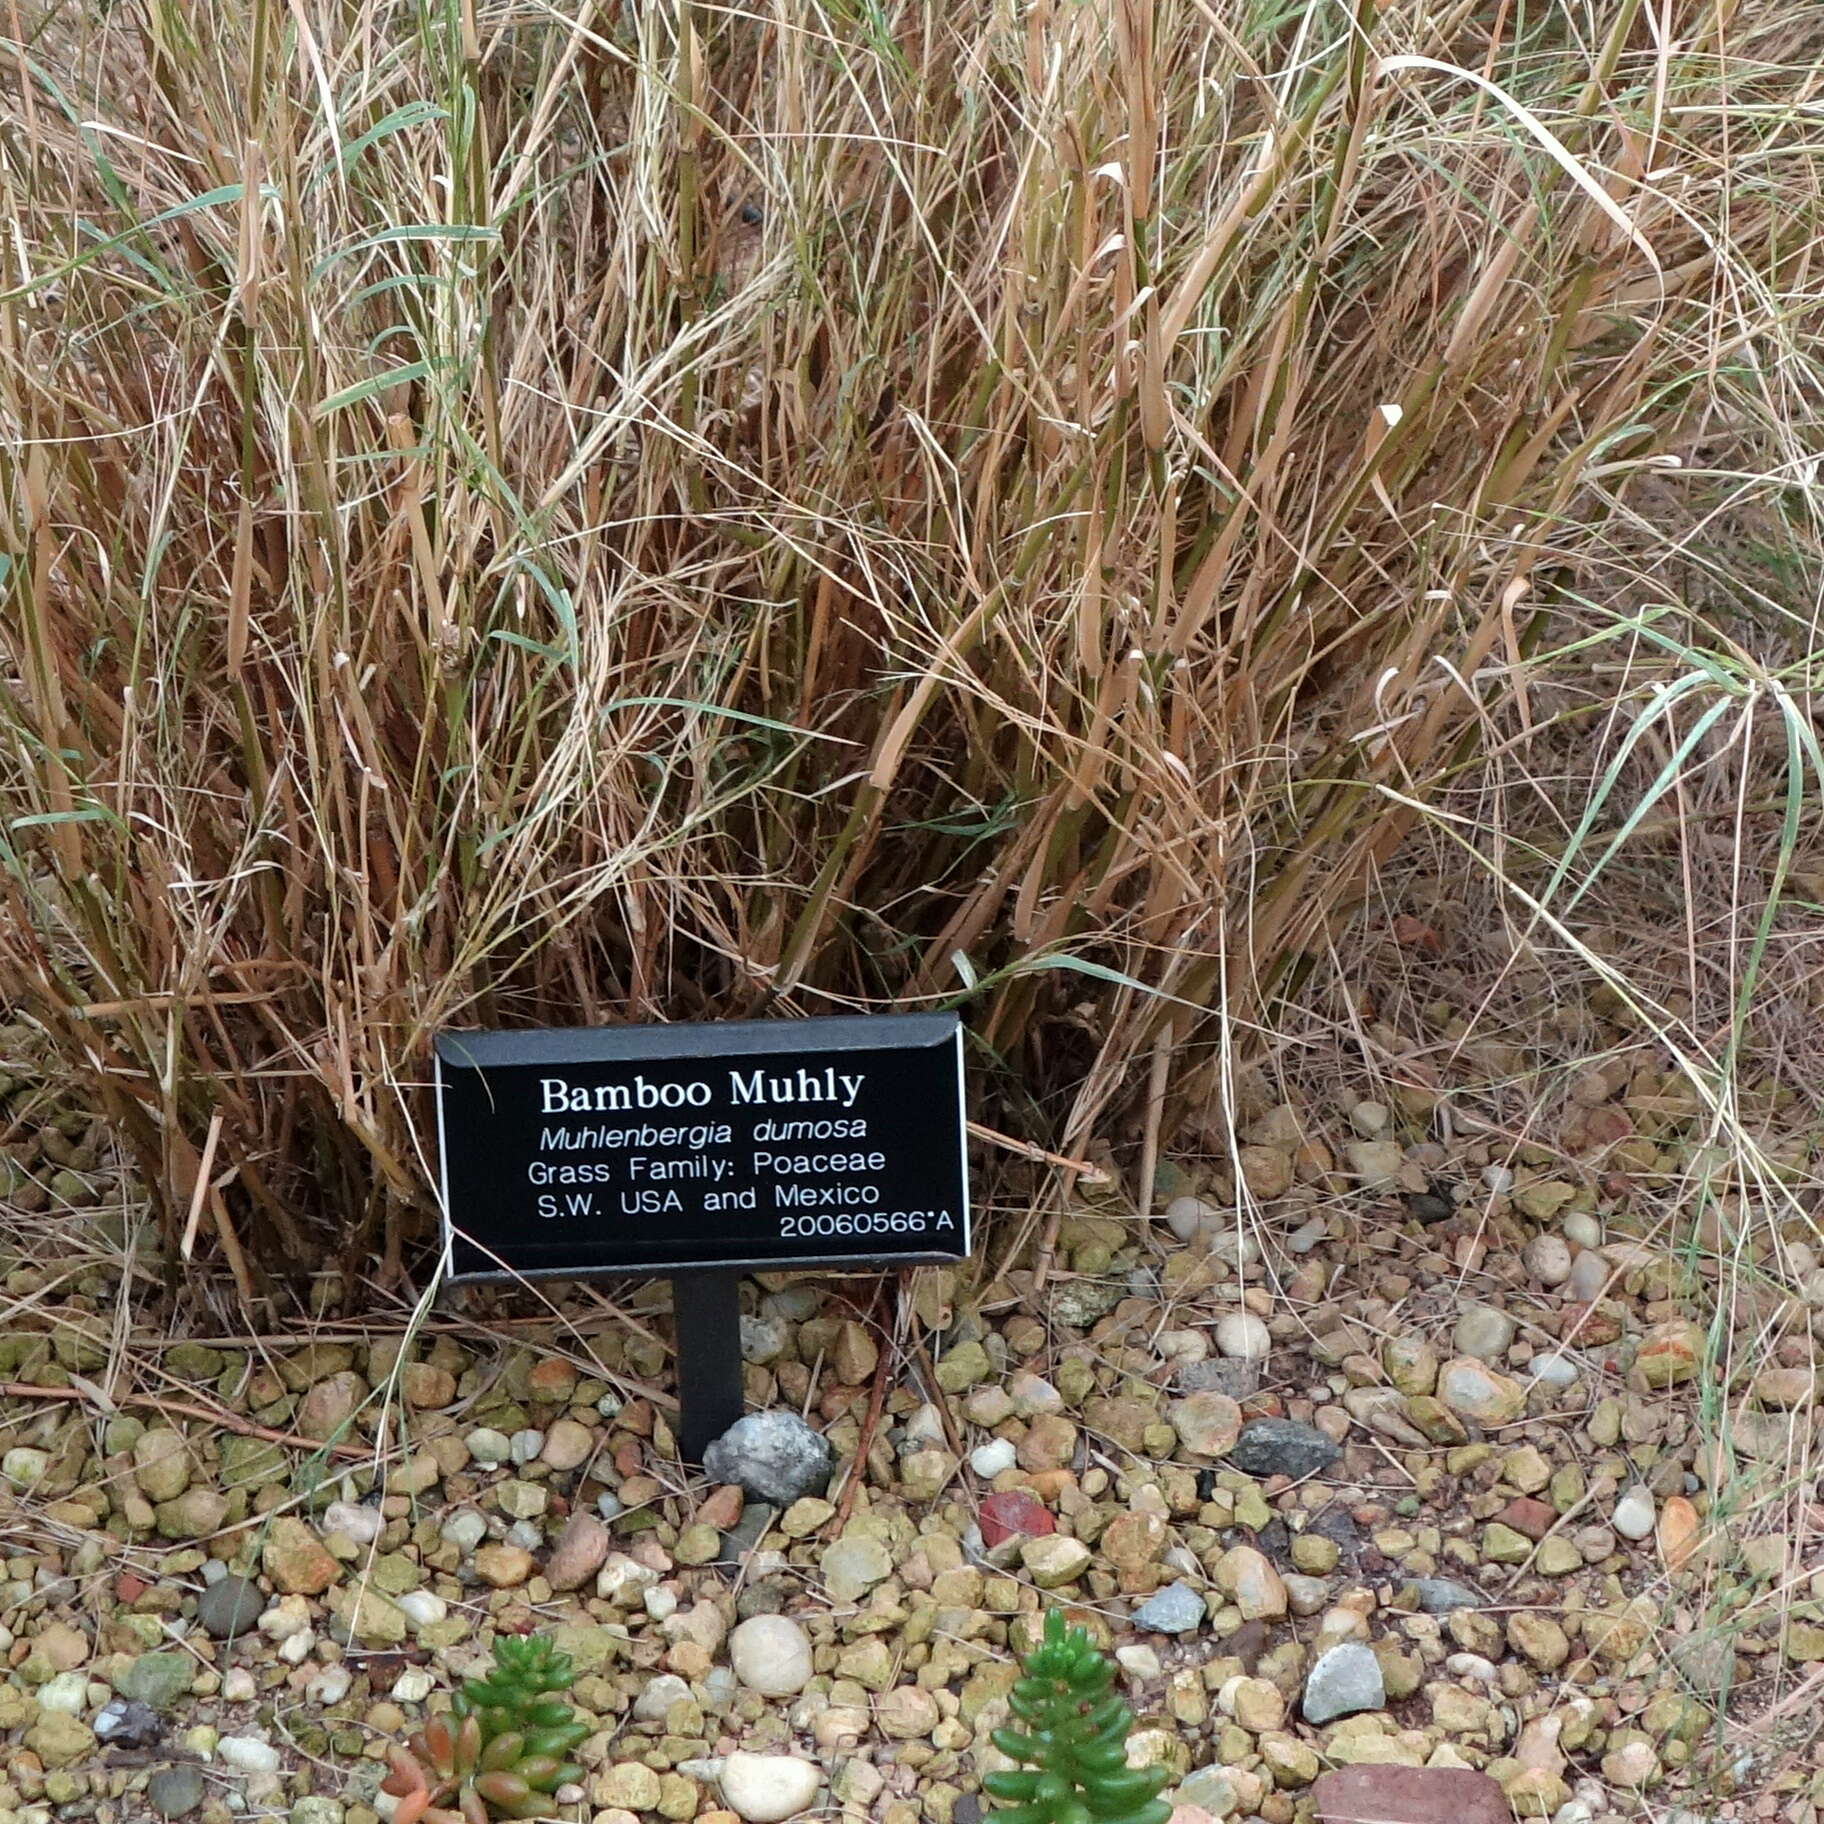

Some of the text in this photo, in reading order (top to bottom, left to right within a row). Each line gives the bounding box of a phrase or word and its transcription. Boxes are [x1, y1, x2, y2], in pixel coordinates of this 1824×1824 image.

[540, 1068, 865, 1113] Bamboo Muhly
[541, 1119, 866, 1150] Muhlenbergia dumosa
[529, 1152, 885, 1184] Grass Family: Poaceae
[539, 1183, 879, 1217] S.W. USA and Mexico
